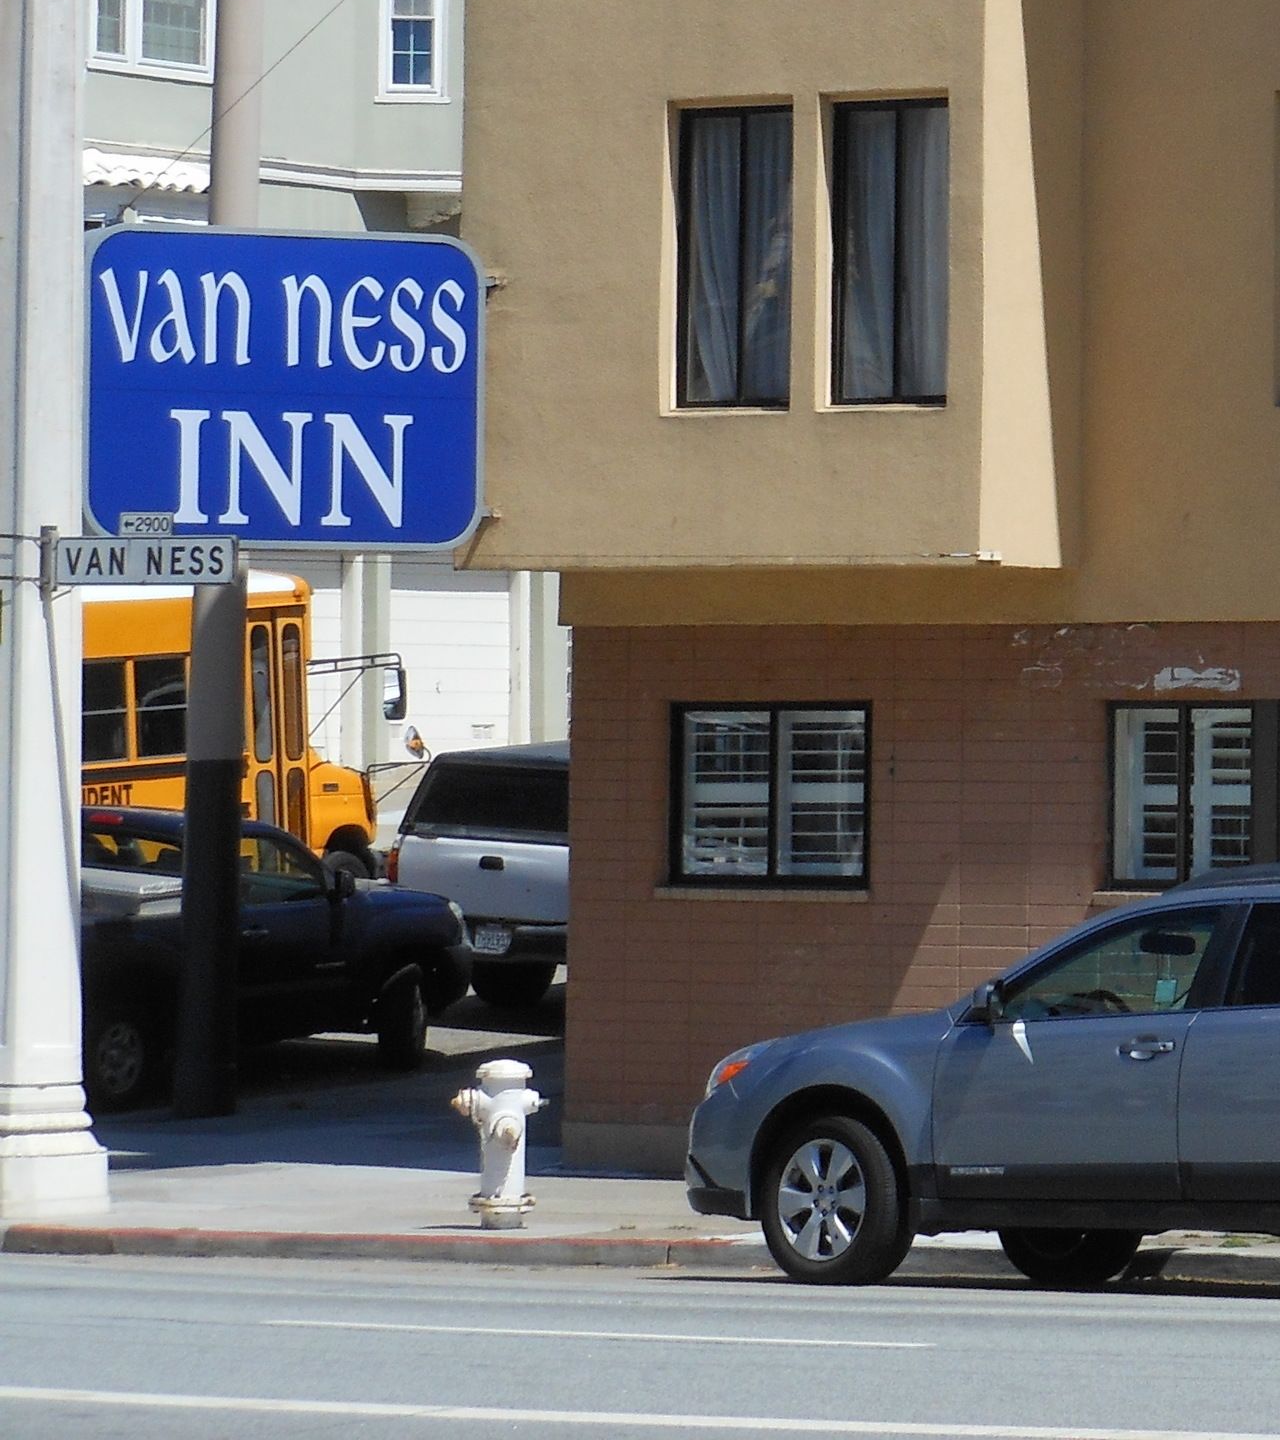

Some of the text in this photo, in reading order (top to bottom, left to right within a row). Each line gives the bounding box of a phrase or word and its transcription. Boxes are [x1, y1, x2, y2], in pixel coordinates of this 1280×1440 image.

[170, 408, 413, 528] INN
[135, 516, 169, 532] 2900
[65, 545, 225, 576] VAN NESS
